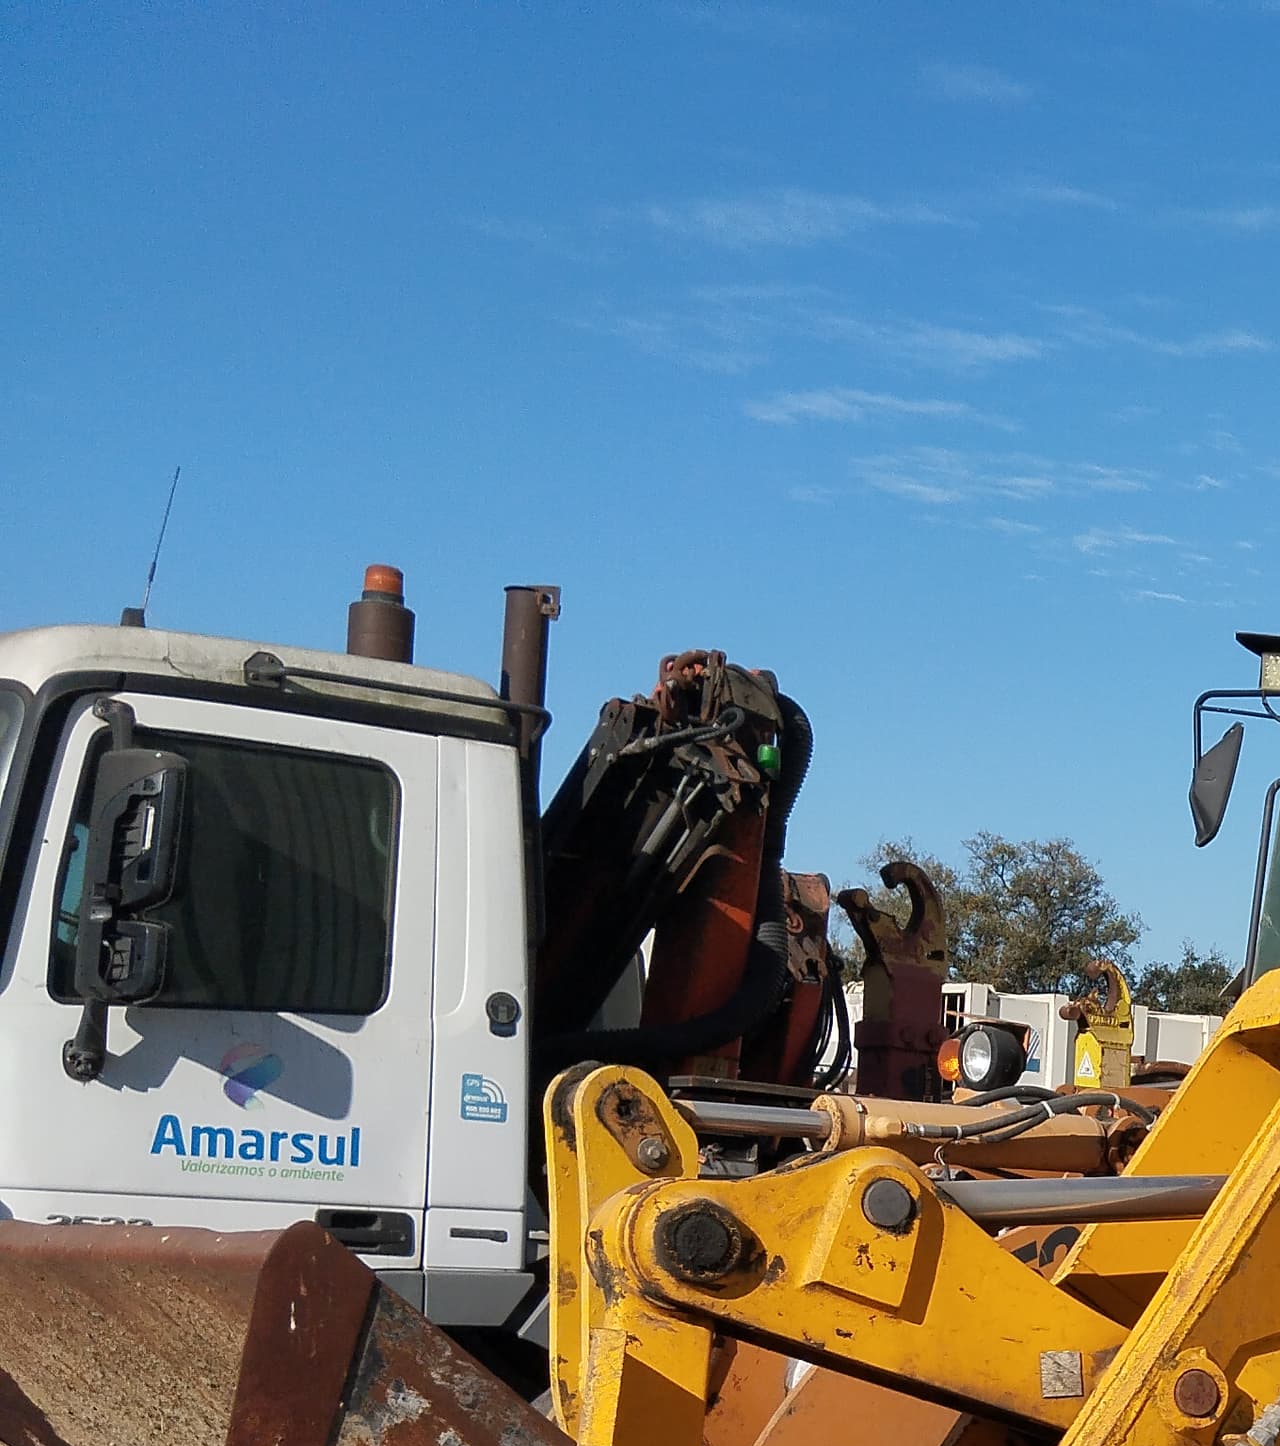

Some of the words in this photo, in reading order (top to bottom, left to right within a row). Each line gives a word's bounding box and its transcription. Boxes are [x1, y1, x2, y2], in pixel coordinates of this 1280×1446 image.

[150, 1113, 361, 1168] Amarsul
[181, 1159, 265, 1178] Valorizamos
[268, 1167, 277, 1178] o
[280, 1165, 345, 1182] ambiente
